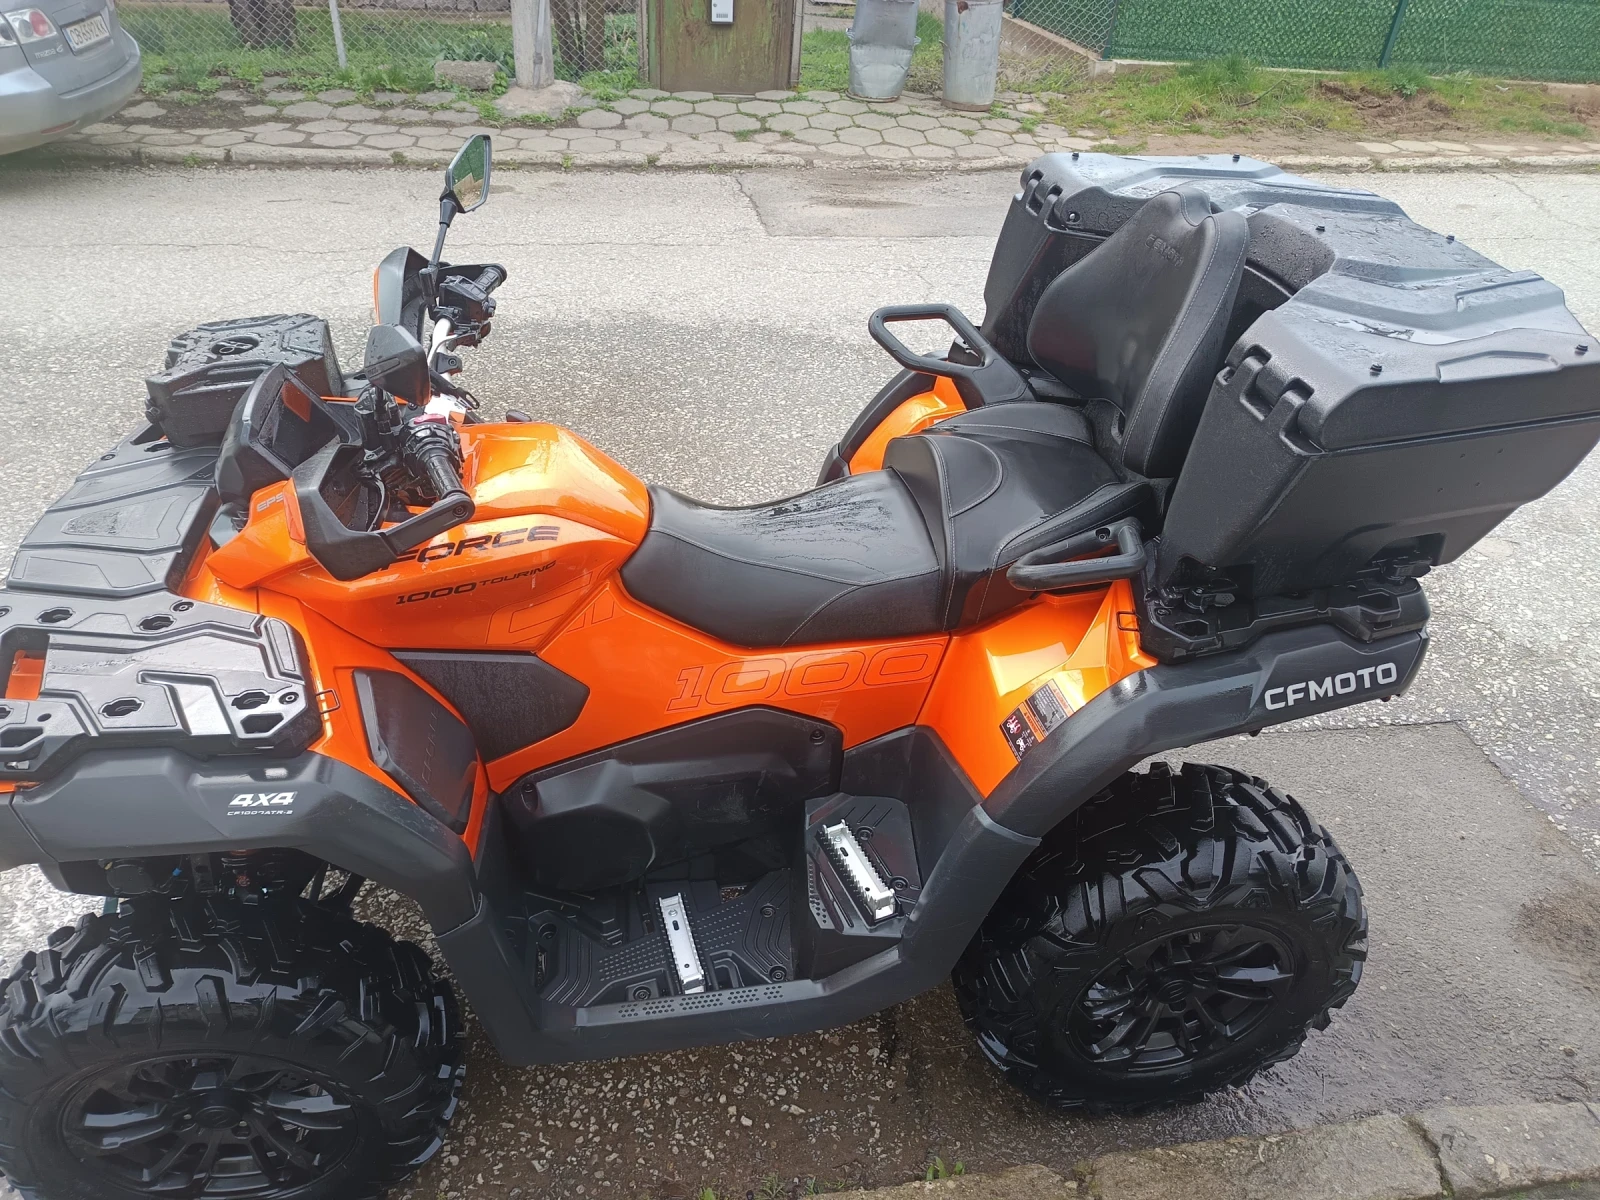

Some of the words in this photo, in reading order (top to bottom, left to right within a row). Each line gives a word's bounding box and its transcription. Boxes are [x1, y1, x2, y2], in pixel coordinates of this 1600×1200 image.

[396, 582, 477, 605] 1000
[479, 560, 556, 586] TOURING
[666, 643, 944, 711] 1000
[1264, 662, 1398, 711] CFMOTO
